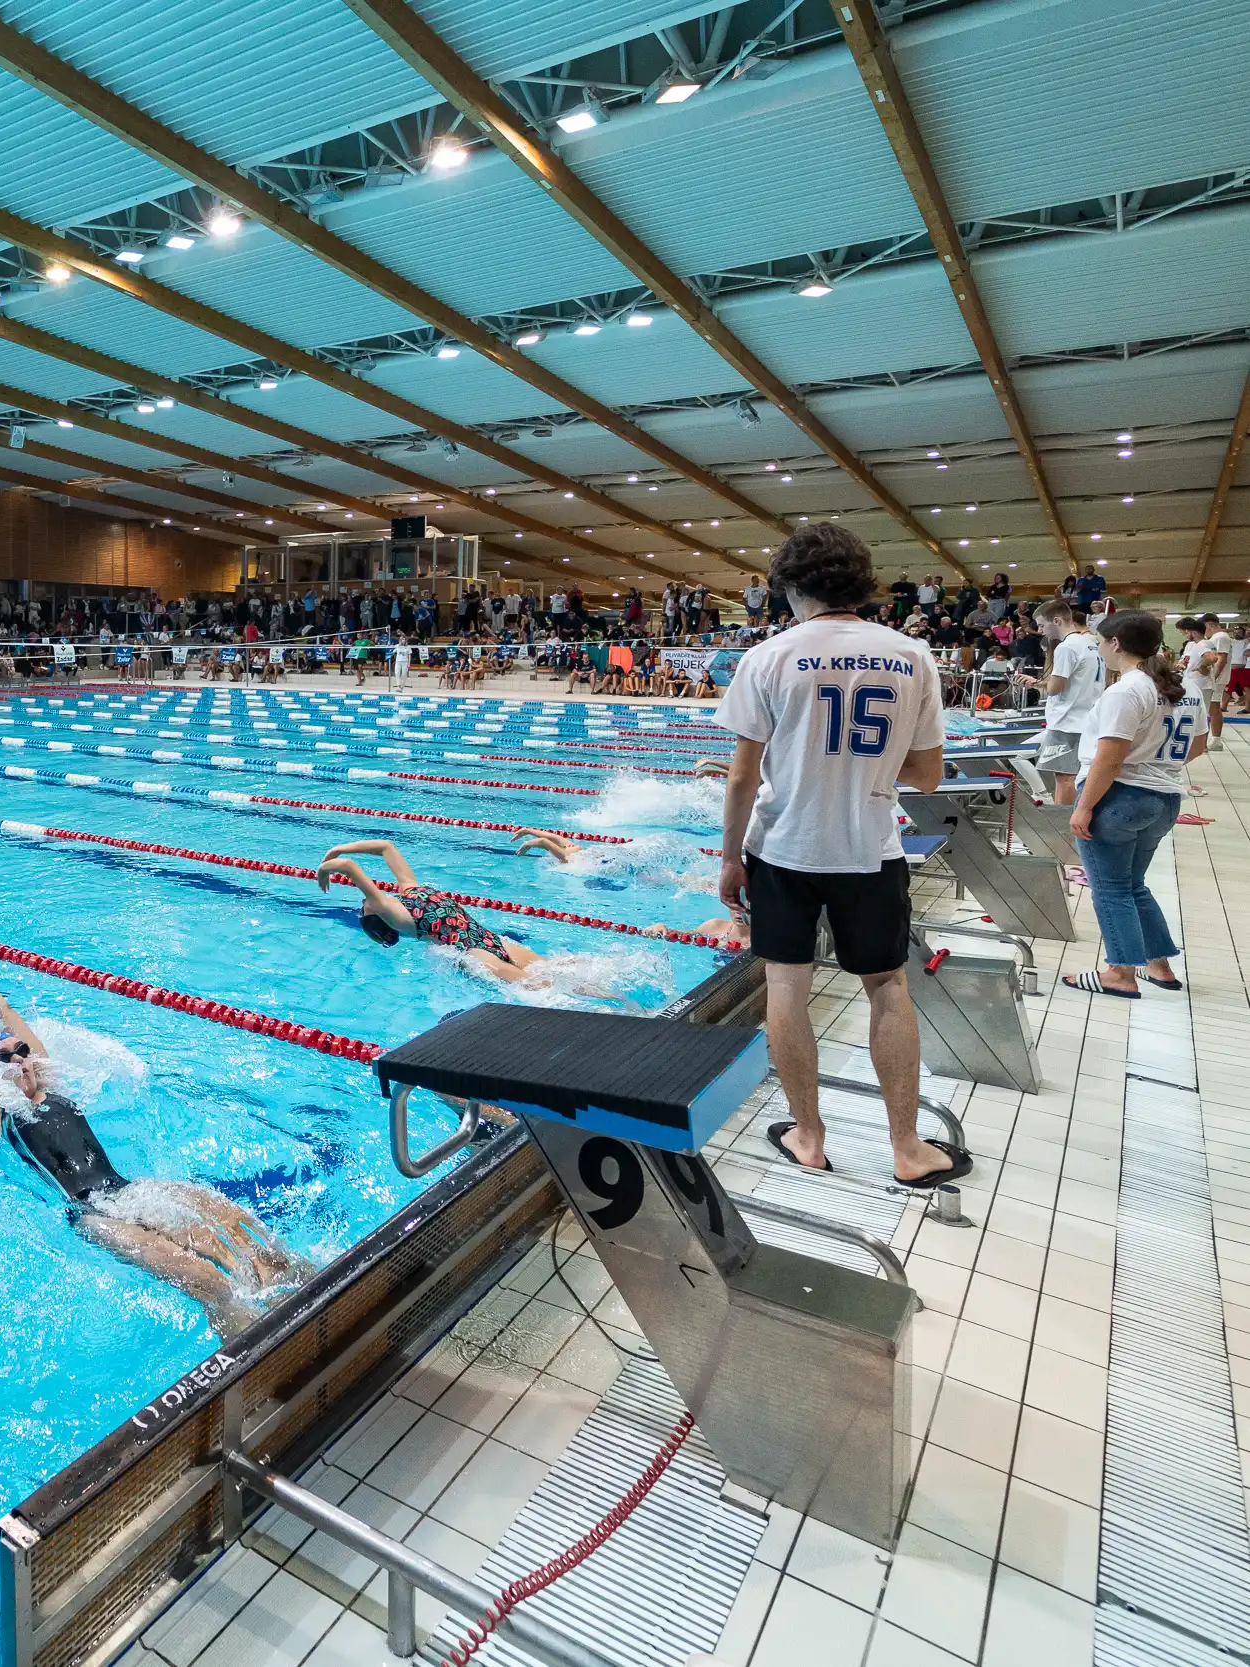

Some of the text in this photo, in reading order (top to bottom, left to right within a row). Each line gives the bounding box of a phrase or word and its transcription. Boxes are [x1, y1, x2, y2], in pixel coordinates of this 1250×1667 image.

[669, 659, 706, 670] SIJEK
[797, 654, 914, 677] SV. KRŠEVAN
[817, 684, 898, 758] 15
[1155, 714, 1195, 761] 15
[1043, 744, 1067, 756] NIKE
[578, 1136, 645, 1230] 9
[161, 1353, 236, 1409] OMEGA
